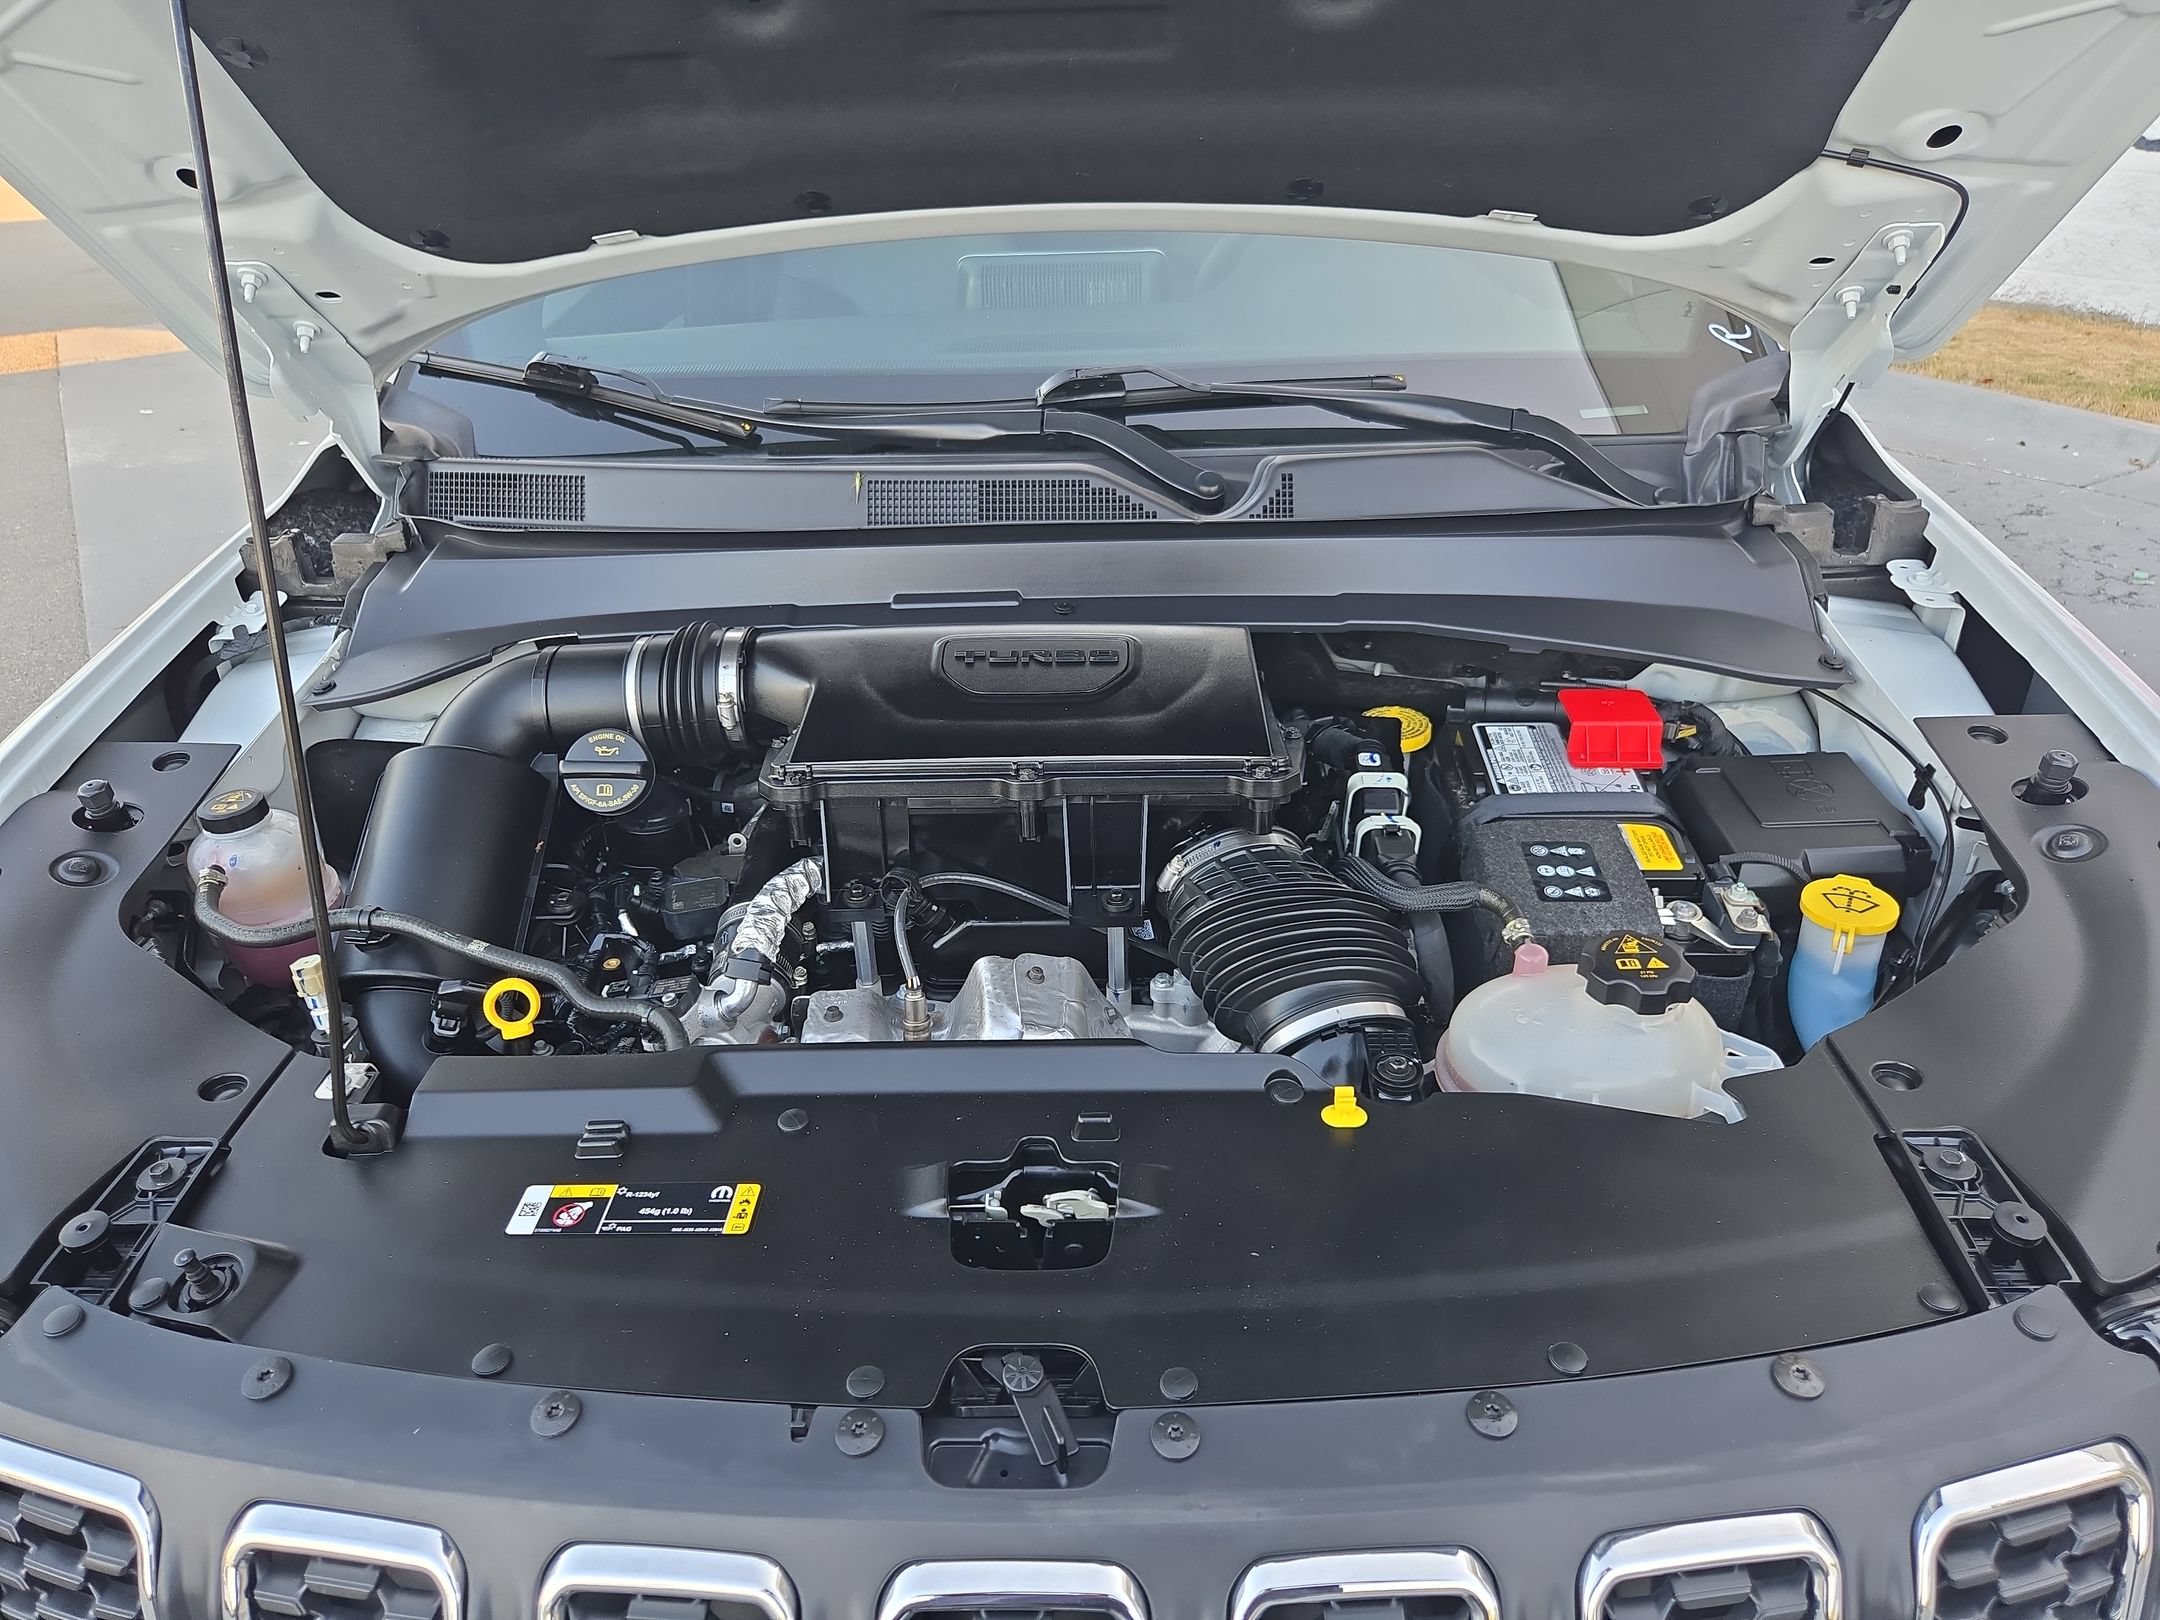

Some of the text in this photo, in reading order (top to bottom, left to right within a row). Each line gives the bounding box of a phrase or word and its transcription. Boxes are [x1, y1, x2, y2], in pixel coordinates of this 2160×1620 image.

[954, 649, 1120, 664] TURBO
[588, 733, 626, 743] ENGINE OIL
[571, 784, 579, 795] API
[626, 1191, 660, 1199] R-1234yf
[638, 1207, 693, 1216] 454g (1.0 lb)
